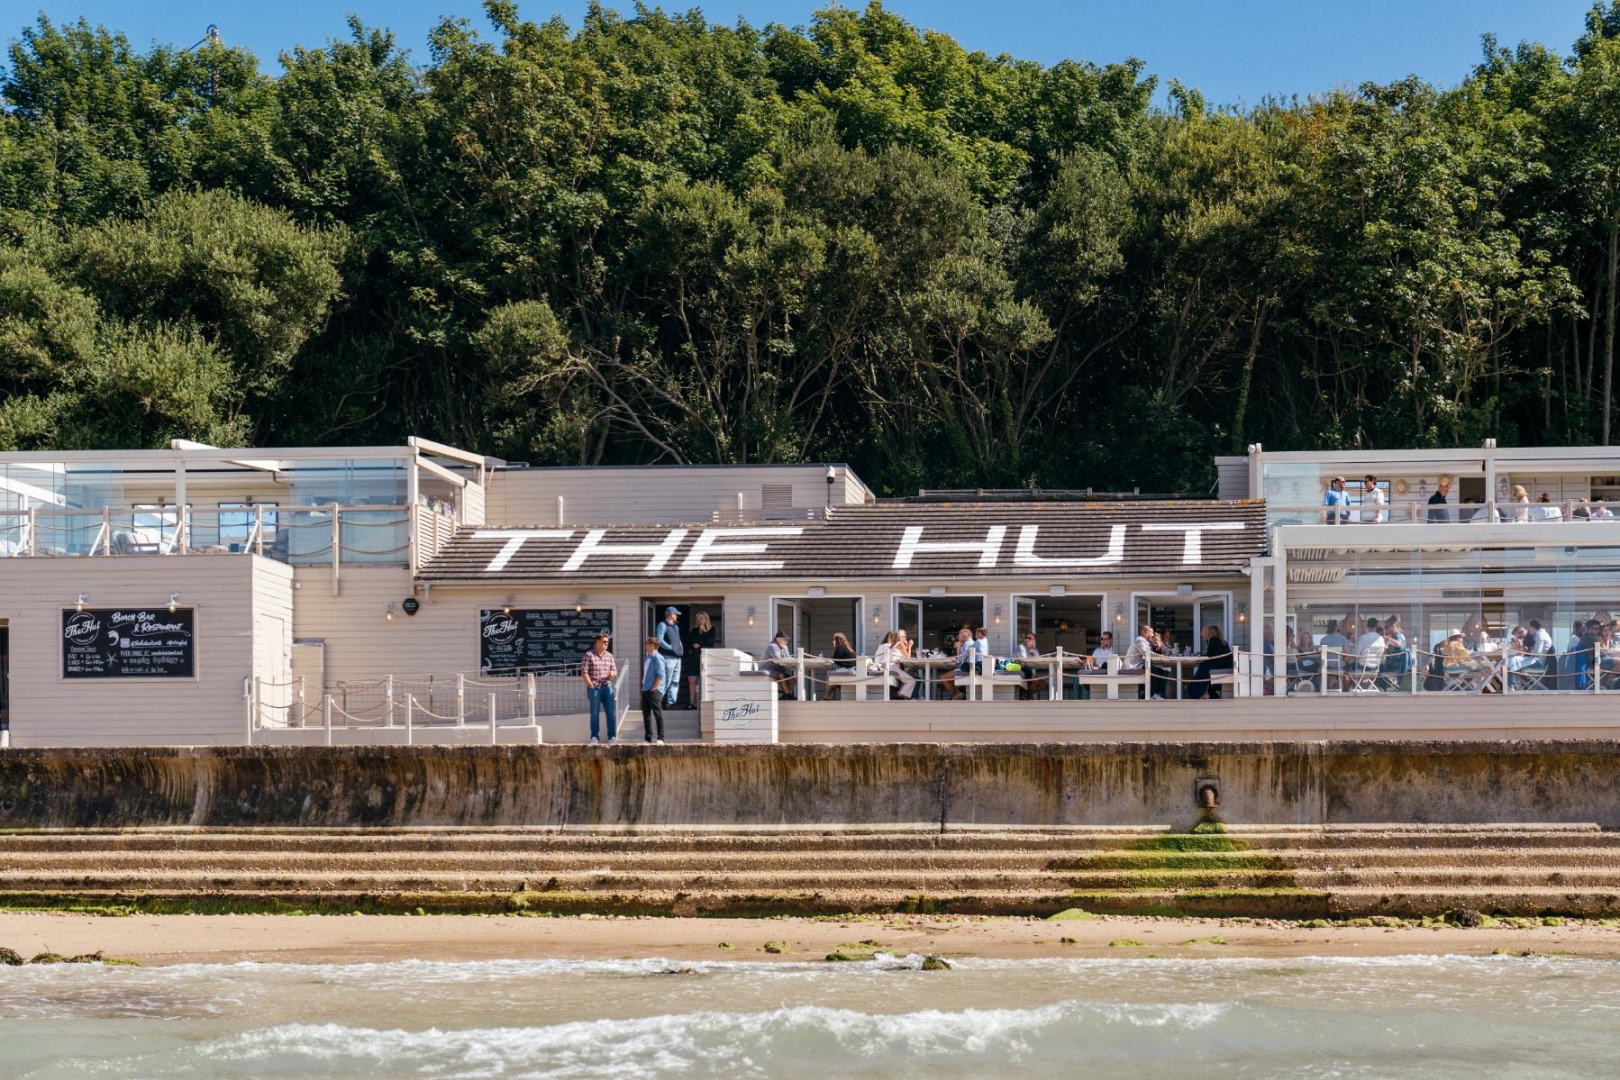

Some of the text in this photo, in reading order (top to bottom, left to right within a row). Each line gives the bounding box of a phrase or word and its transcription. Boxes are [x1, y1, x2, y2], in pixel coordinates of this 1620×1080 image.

[471, 522, 1245, 571] THE HUT
[65, 623, 82, 638] The
[81, 619, 101, 633] Hut
[483, 623, 500, 638] The
[500, 619, 519, 634] Hut
[722, 702, 760, 721] The Hut
